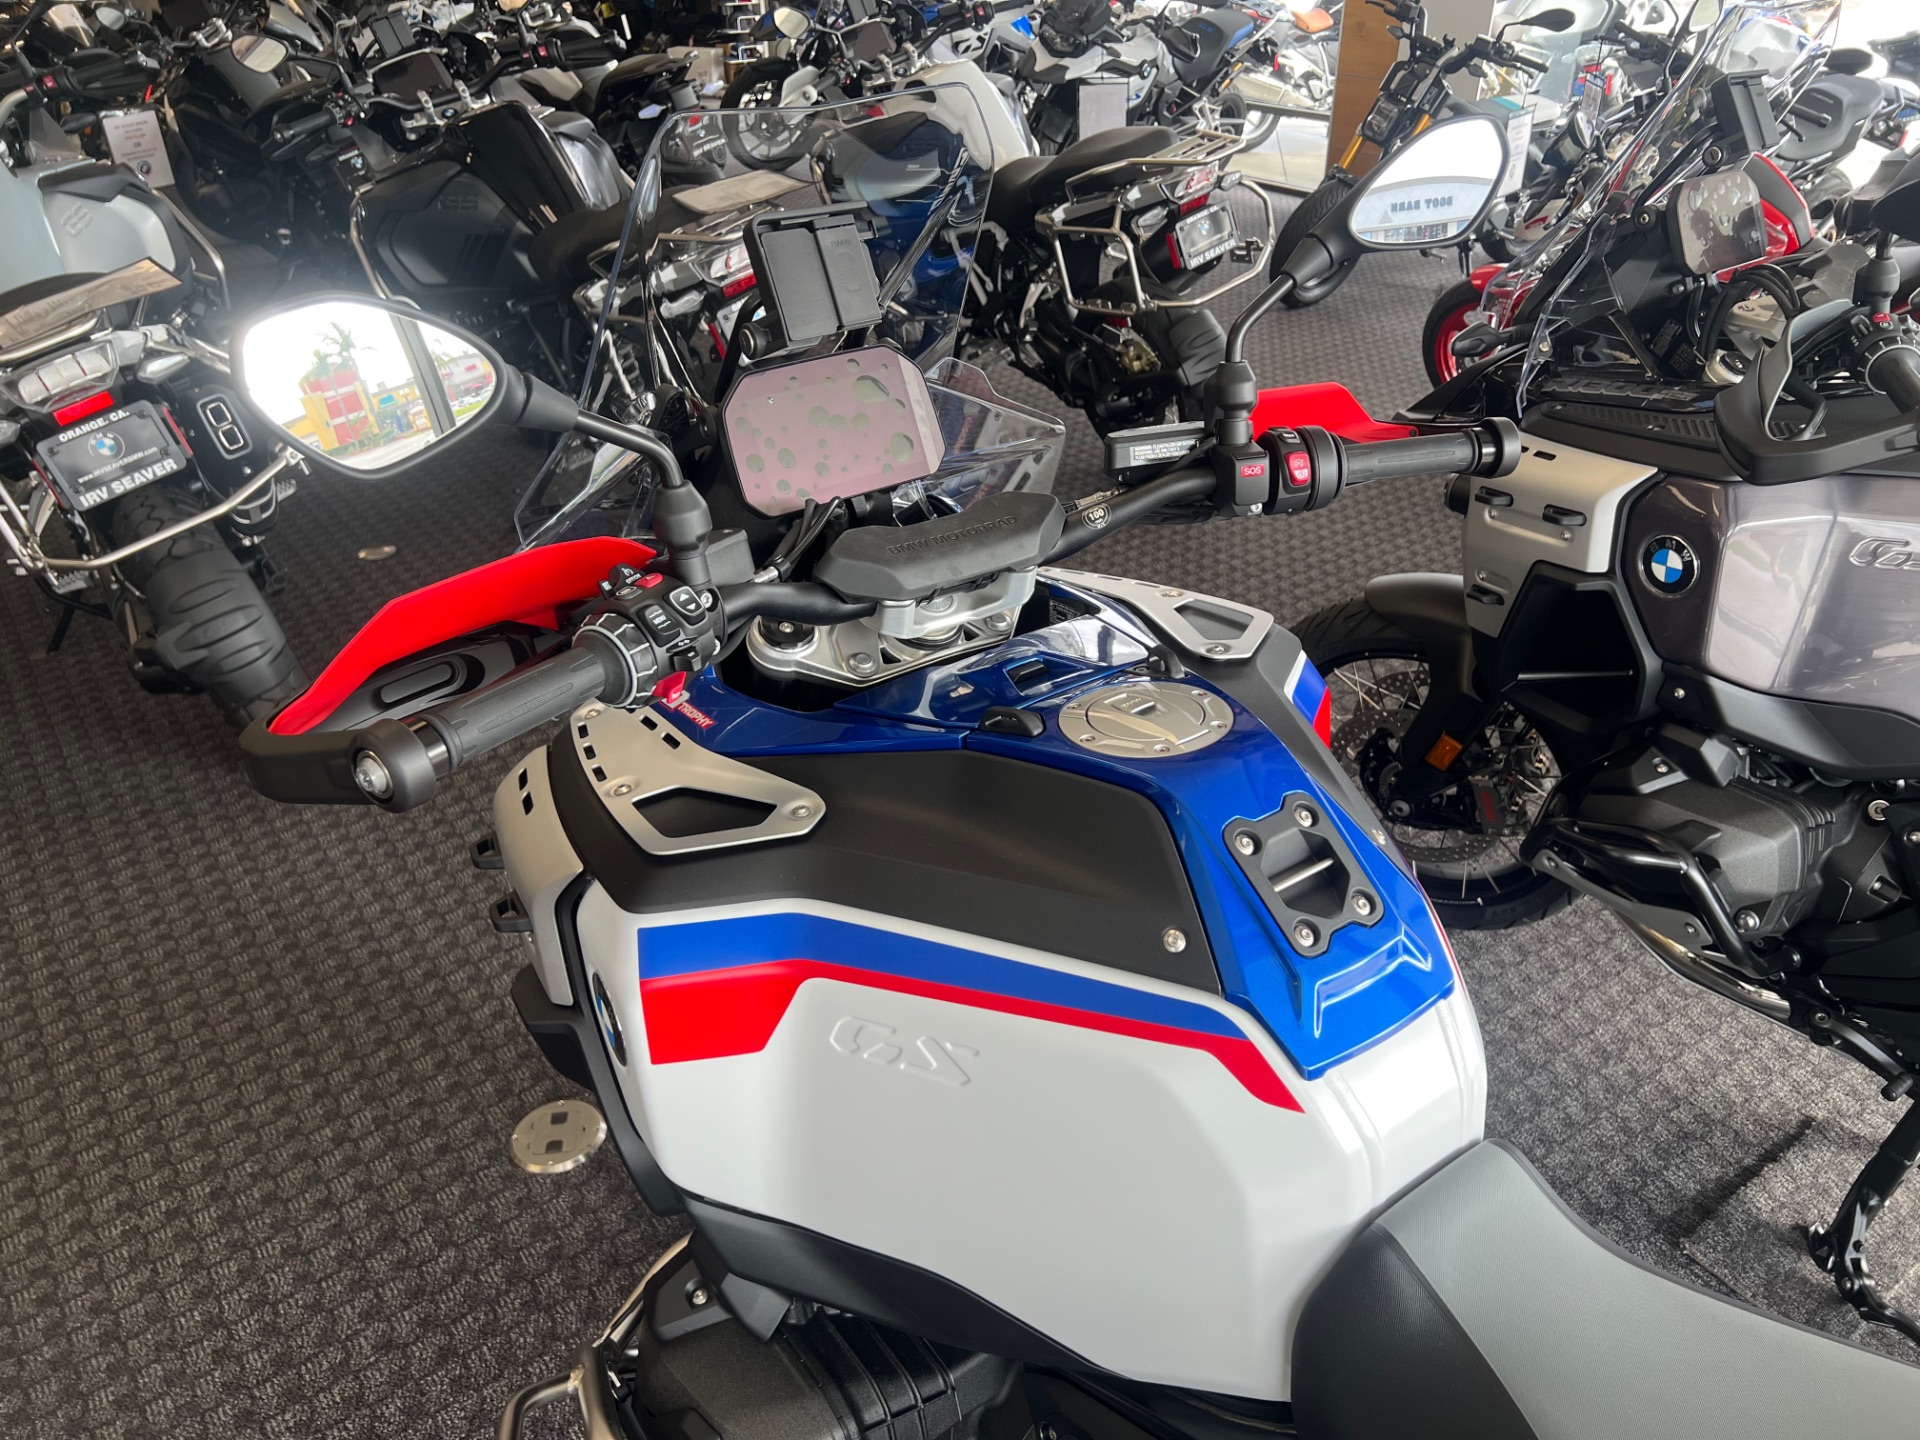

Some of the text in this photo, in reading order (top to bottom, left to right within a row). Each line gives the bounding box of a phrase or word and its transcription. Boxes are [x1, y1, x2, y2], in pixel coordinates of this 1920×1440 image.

[1190, 255, 1204, 268] IRV
[1204, 239, 1236, 260] SEAVER
[79, 458, 178, 508] IRV SEAVER
[1244, 466, 1262, 475] SOS
[1088, 508, 1105, 521] 100
[887, 515, 1019, 556] BMW MOTORRAD
[652, 614, 667, 625] MENU
[678, 701, 714, 727] TROPHY
[830, 1014, 981, 1087] GS
